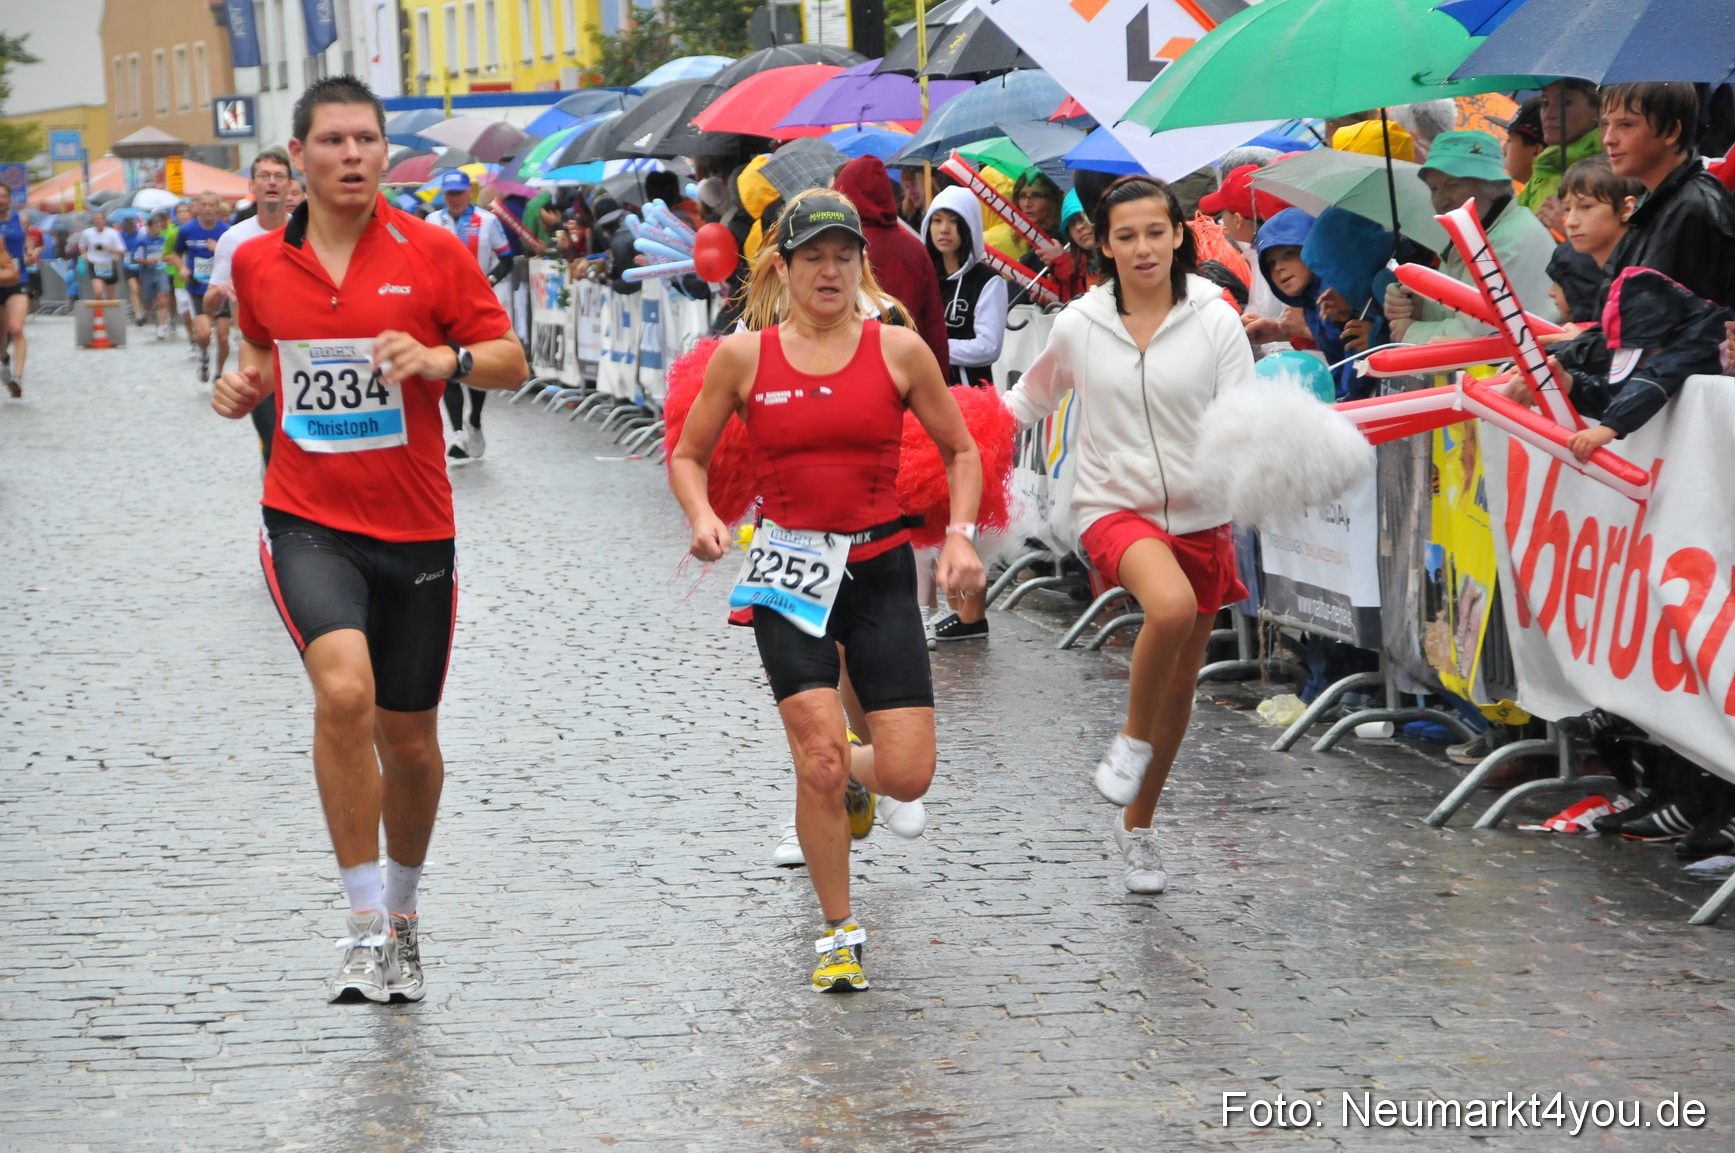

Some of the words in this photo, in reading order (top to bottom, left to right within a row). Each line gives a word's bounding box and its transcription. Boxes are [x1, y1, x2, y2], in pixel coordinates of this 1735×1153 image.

[968, 173, 1045, 243] AUSTRIA
[389, 284, 412, 295] asics
[944, 299, 969, 328] C
[1471, 243, 1562, 391] AUSTRIA
[293, 368, 390, 411] 2334
[307, 417, 379, 437] Christoph
[425, 568, 446, 581] asics
[746, 547, 830, 600] 2252
